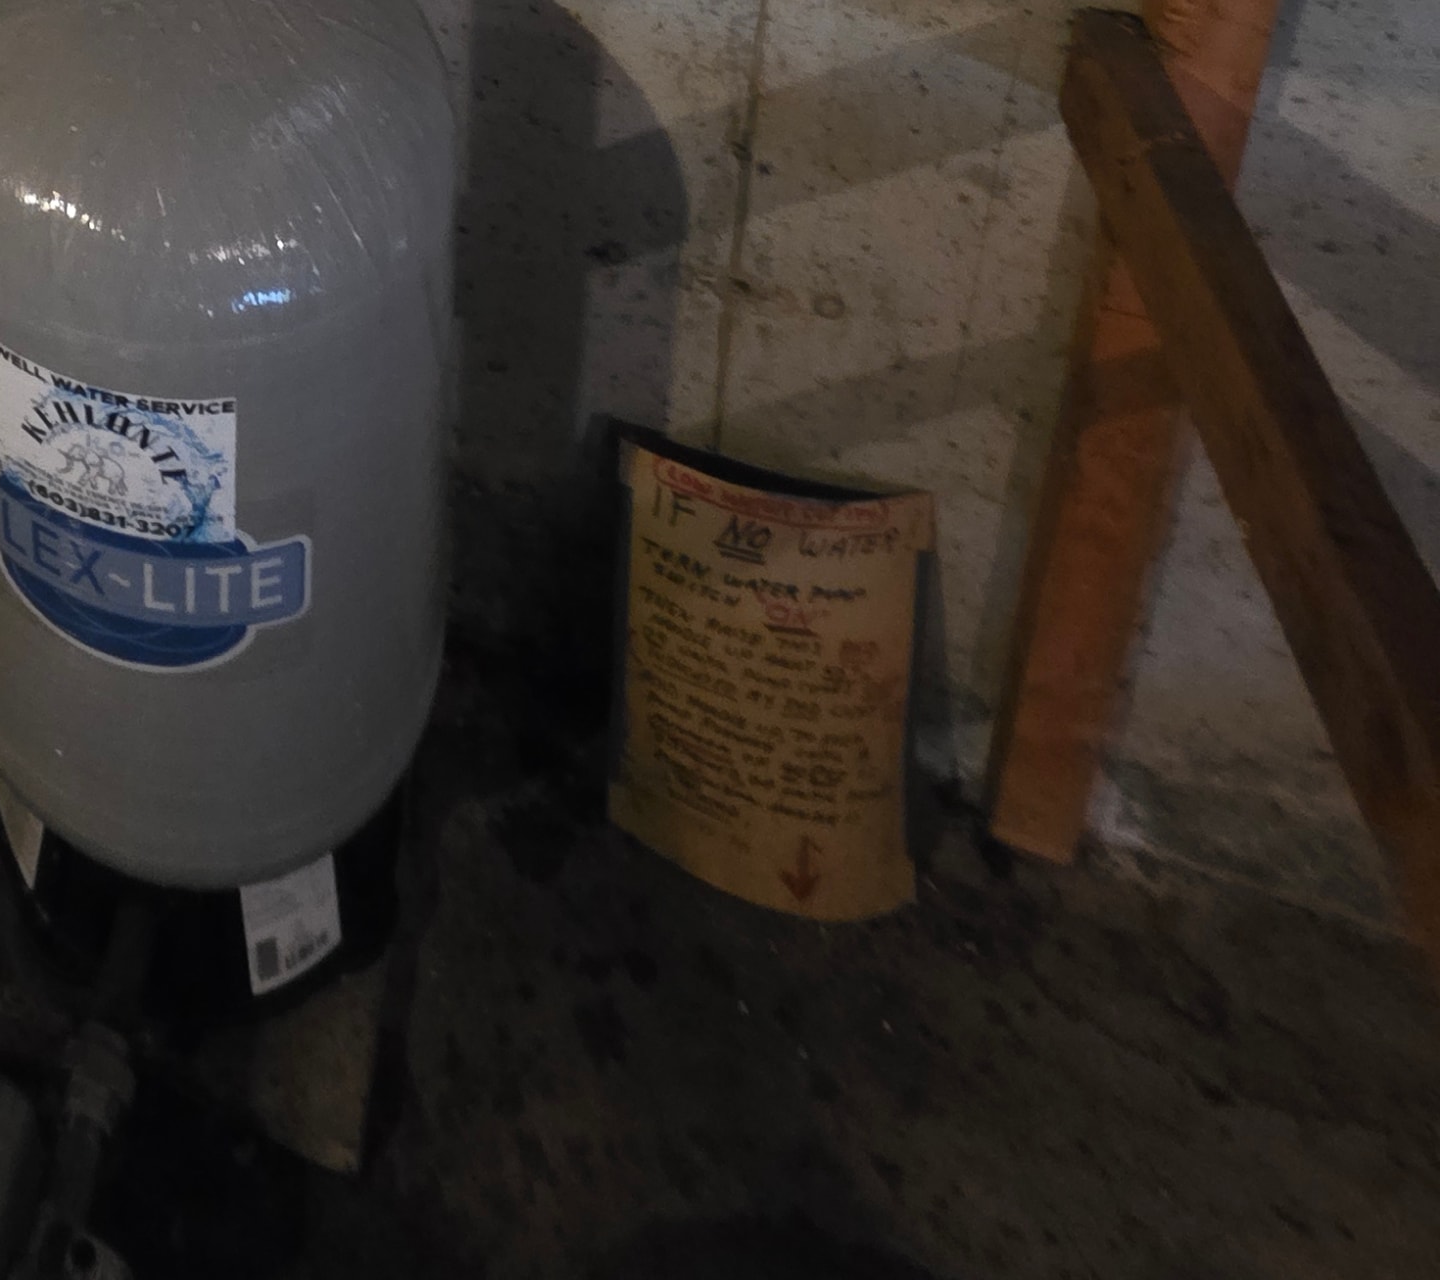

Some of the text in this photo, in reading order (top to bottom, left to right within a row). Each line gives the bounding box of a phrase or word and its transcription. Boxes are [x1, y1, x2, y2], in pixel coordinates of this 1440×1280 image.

[51, 373, 129, 407] WATER
[136, 397, 236, 420] SERVICE
[28, 478, 195, 539] (603)831-3207
[652, 485, 696, 526] IF
[717, 514, 773, 548] NO
